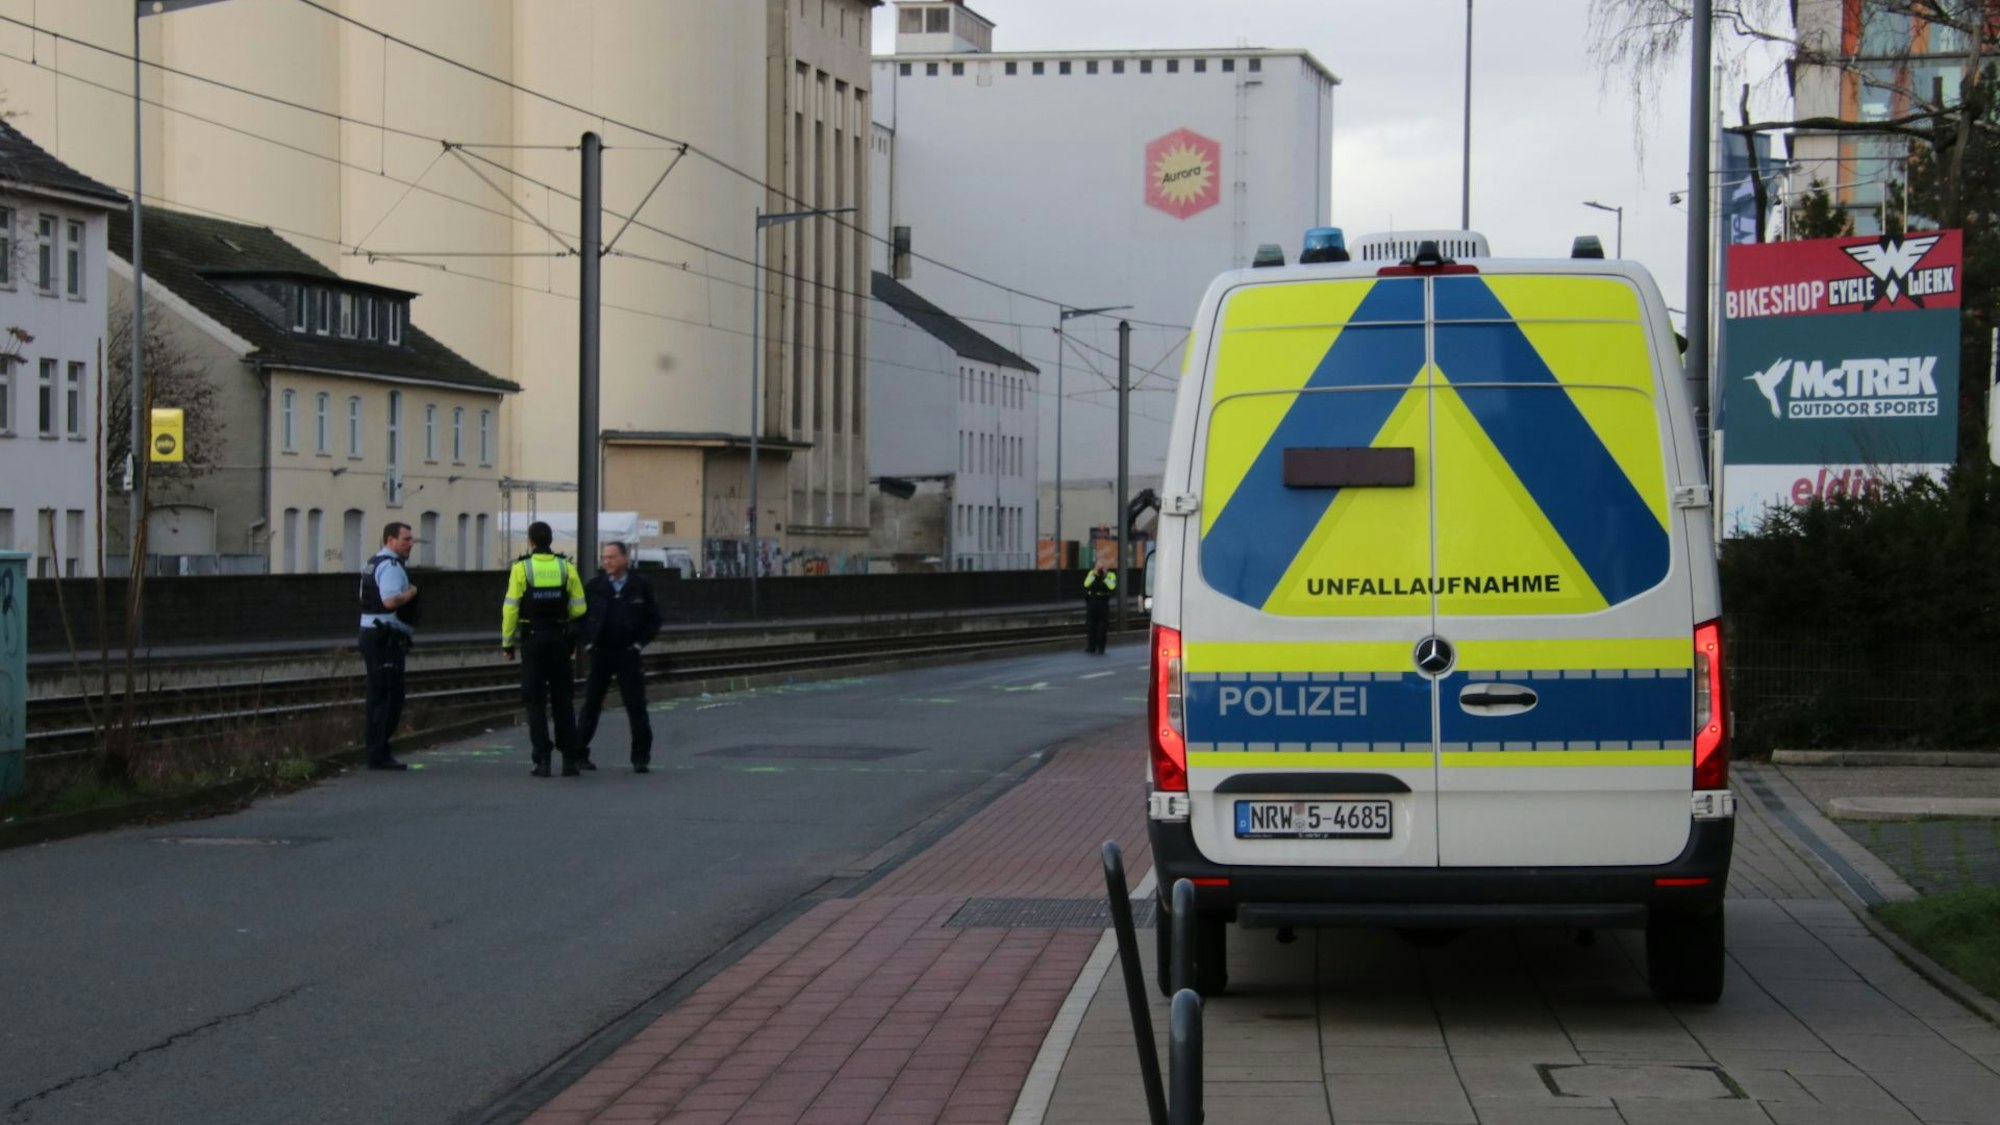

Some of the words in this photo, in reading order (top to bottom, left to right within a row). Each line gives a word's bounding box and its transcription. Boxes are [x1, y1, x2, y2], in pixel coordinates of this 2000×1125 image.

[1162, 166, 1202, 184] Aurora
[1726, 281, 1825, 319] BIKESHOP
[1829, 276, 1875, 305] CYCLE
[1908, 266, 1954, 296] WERX
[1790, 356, 1938, 398] McTREK
[1791, 402, 1869, 416] OUTDOOR
[1874, 400, 1936, 415] SPORTS
[1791, 468, 1883, 506] eldi
[1307, 574, 1560, 596] UNFALLAUFNAHME
[1218, 685, 1368, 717] POLIZEI
[1251, 805, 1293, 829] NRW
[1308, 805, 1388, 829] 5-4685
